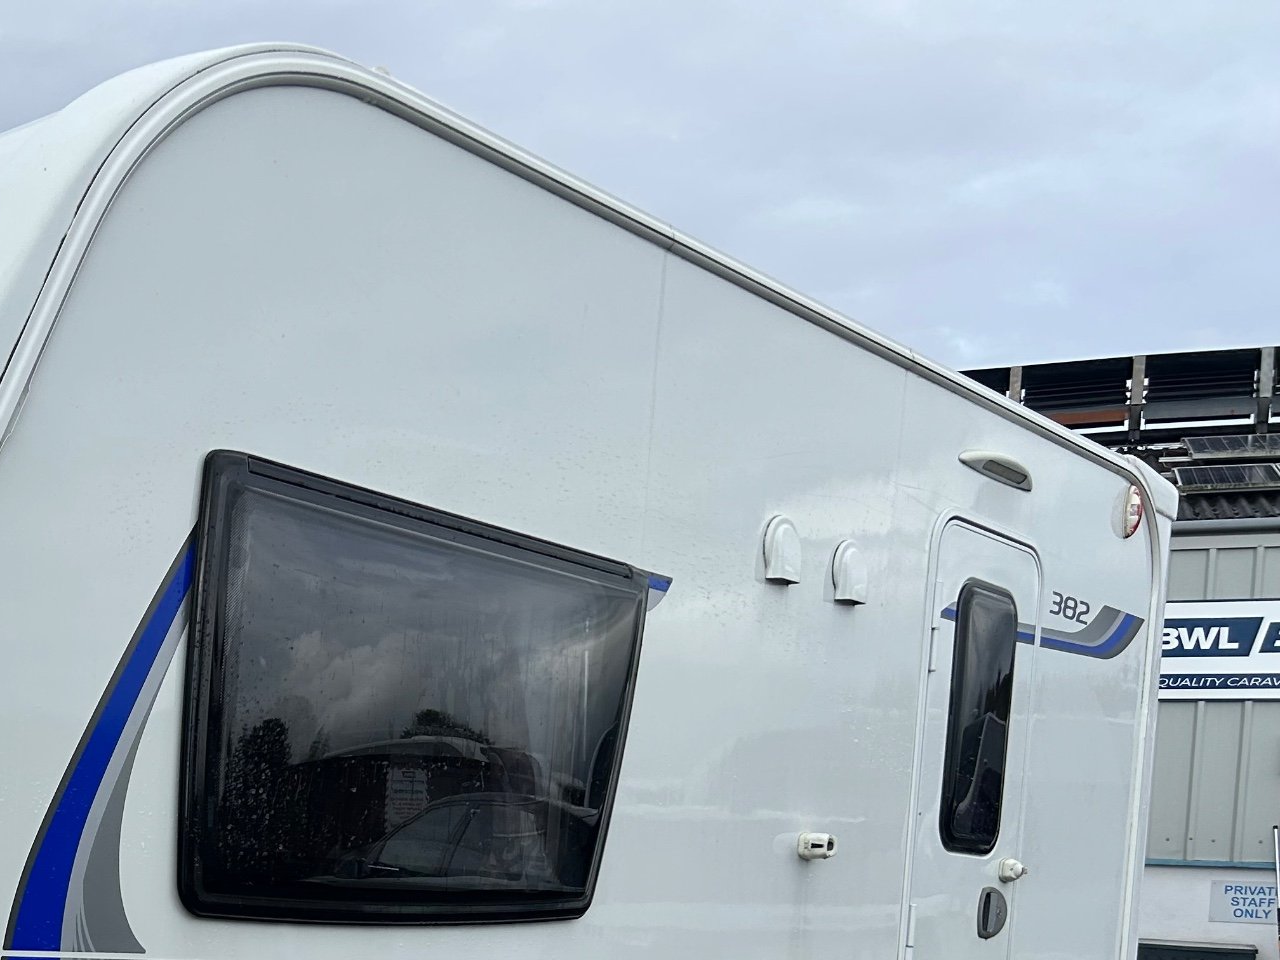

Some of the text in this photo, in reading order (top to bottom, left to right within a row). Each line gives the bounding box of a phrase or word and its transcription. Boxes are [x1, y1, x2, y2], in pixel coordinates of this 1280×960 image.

[1049, 591, 1090, 626] 382
[1161, 626, 1239, 651] BWL
[1159, 677, 1225, 688] QUALITY
[1224, 884, 1278, 896] PRIVAT
[1230, 896, 1276, 908] STAFF
[1233, 908, 1272, 919] ONLY
